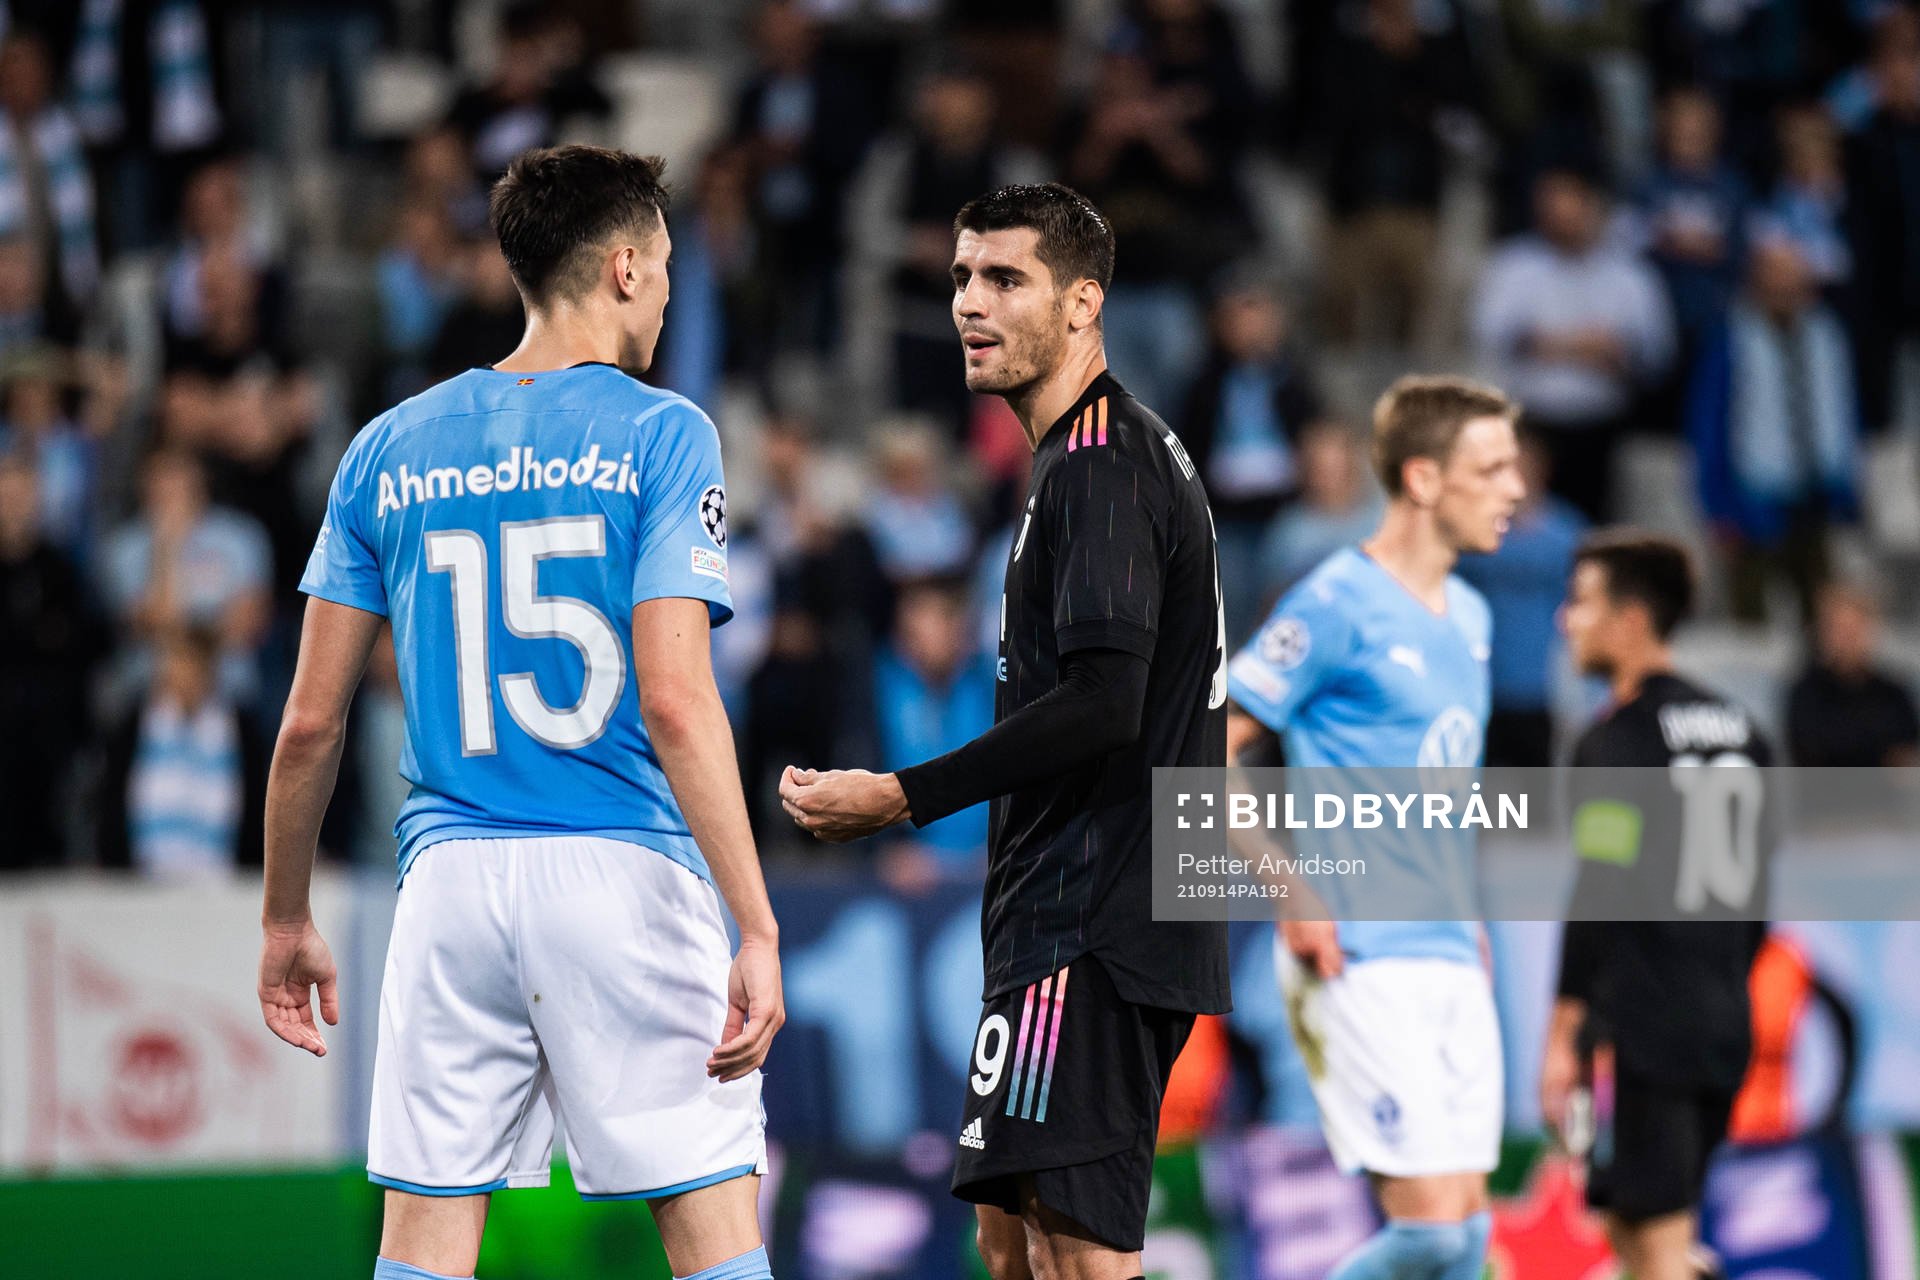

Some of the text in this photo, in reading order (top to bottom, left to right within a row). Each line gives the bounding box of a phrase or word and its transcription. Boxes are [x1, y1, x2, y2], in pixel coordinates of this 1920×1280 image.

[424, 514, 627, 758] 15
[1669, 751, 1764, 914] 10
[971, 1013, 1010, 1096] 9
[959, 1135, 985, 1150] adidas
